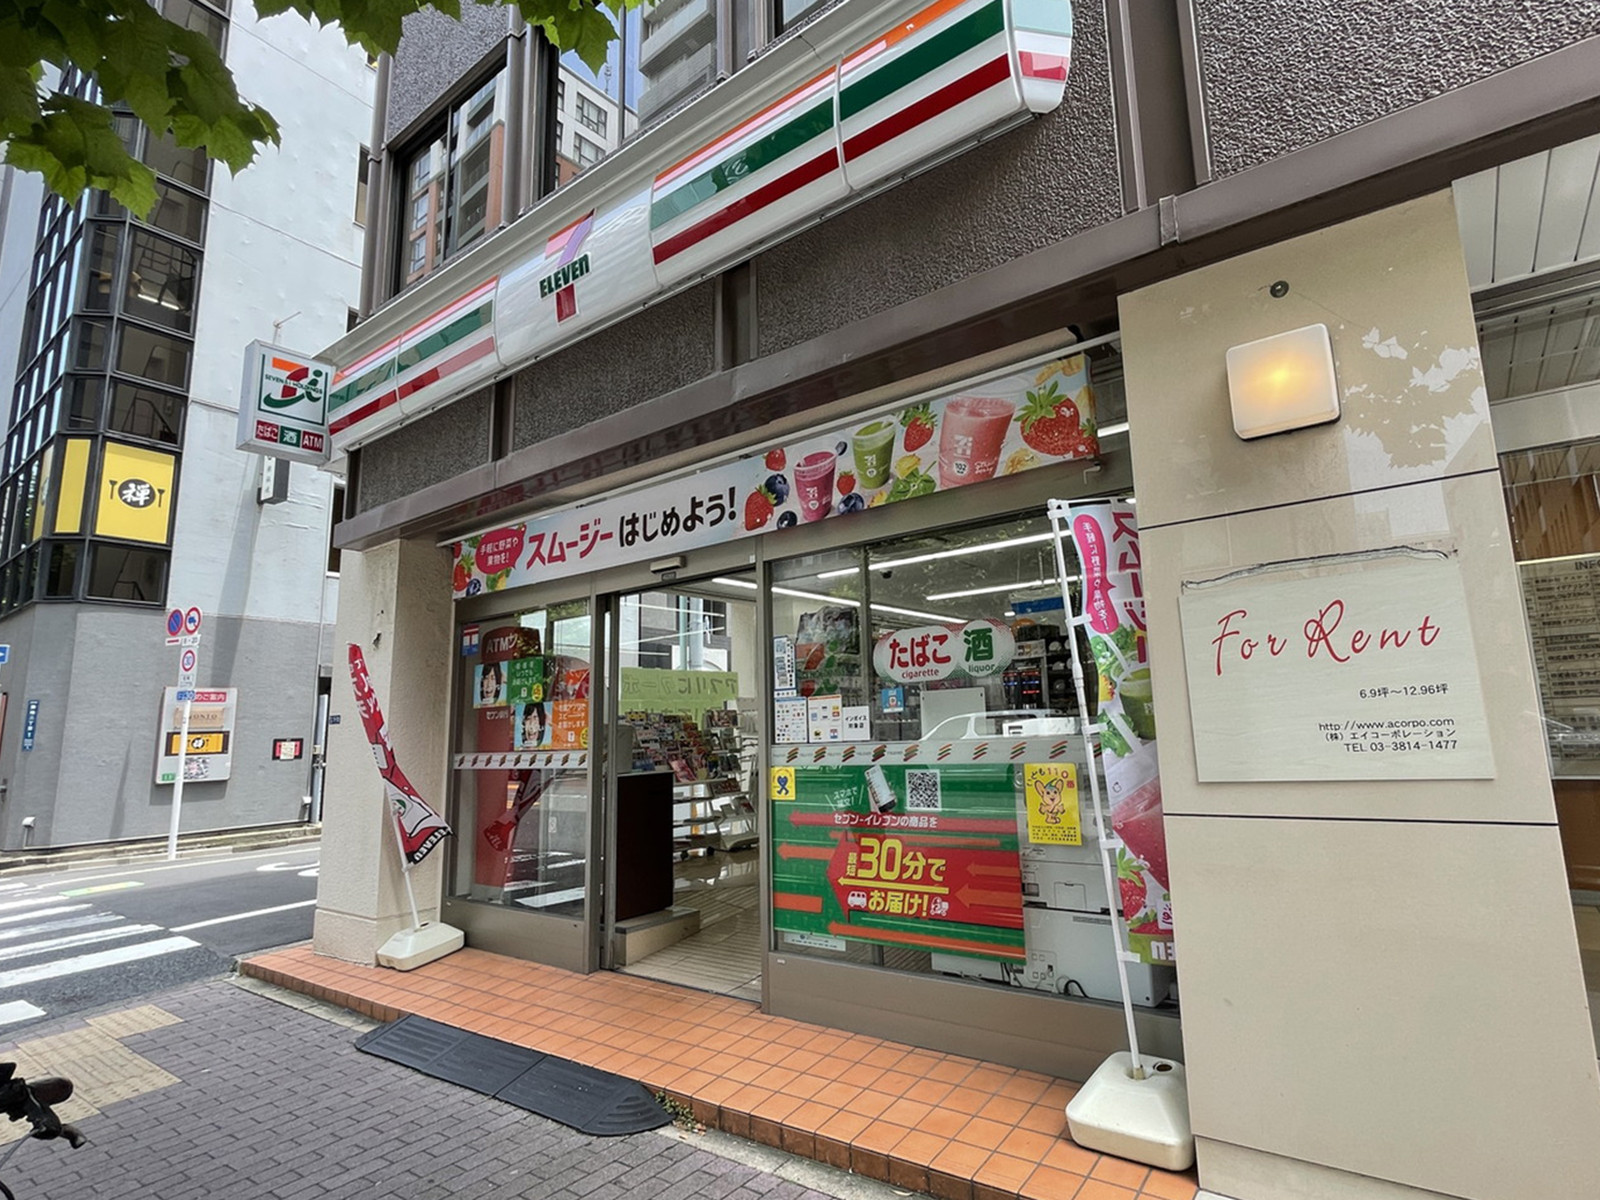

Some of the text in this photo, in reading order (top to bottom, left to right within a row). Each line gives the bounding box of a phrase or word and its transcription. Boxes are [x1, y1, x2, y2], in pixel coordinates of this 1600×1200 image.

[257, 424, 322, 450] たばこ 酒 ATM
[527, 486, 737, 570] スムージー はじめよう!
[480, 537, 519, 556] 手軽に野菜や
[487, 551, 510, 567] 果物を!
[889, 627, 993, 669] たばこ 酒
[1212, 599, 1441, 675] For Rent
[901, 663, 995, 679] cigarette liquor
[1344, 740, 1458, 753] TEL 03-3814-1477
[857, 837, 947, 882] 30分で
[868, 890, 929, 916] お届け!
